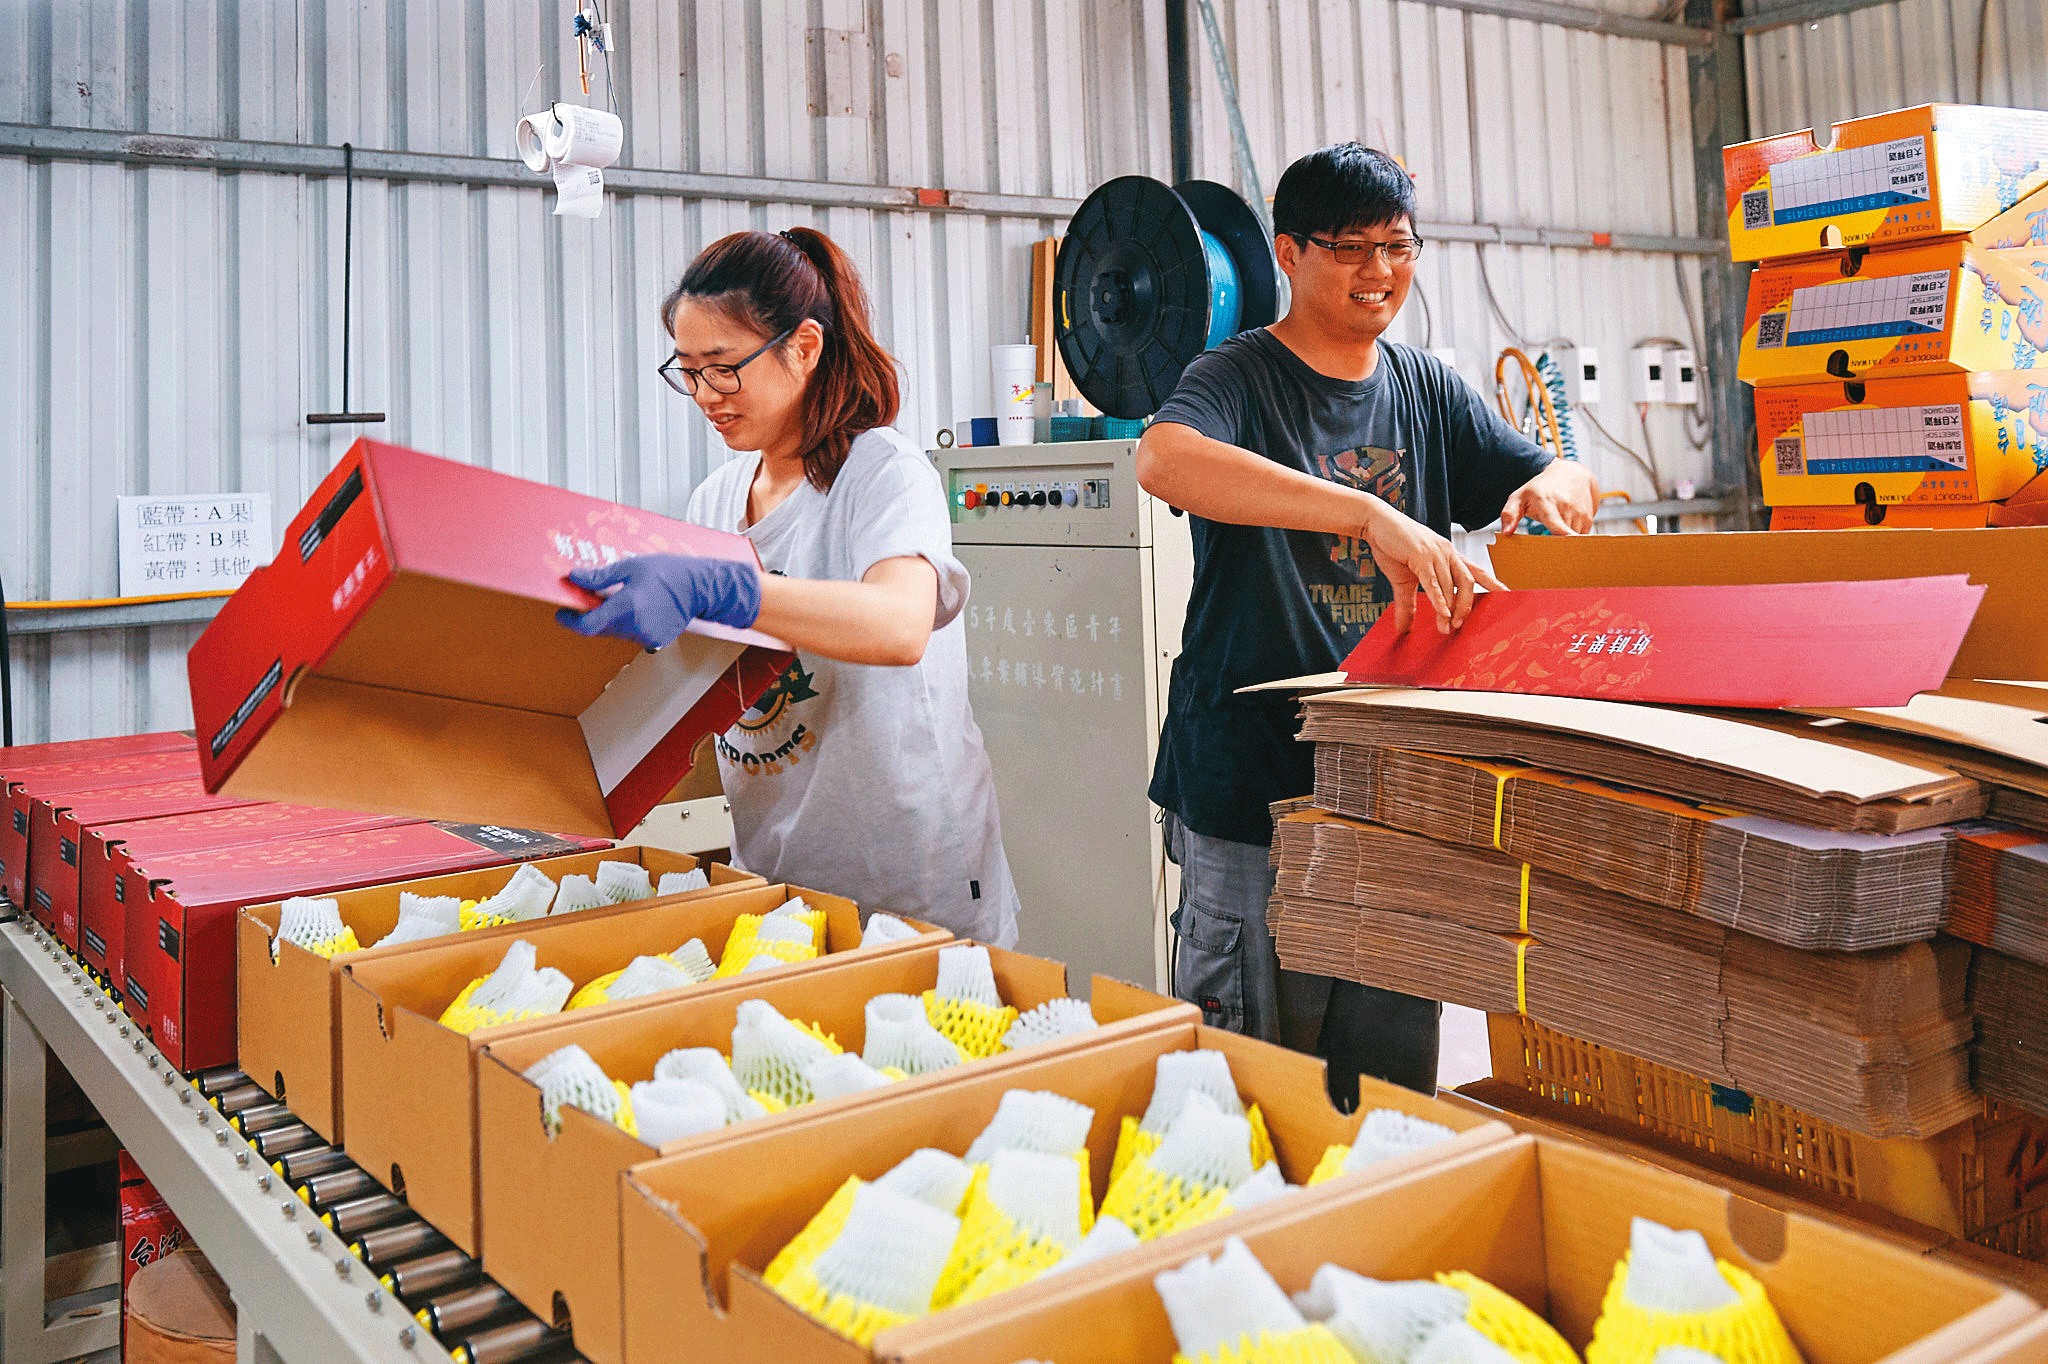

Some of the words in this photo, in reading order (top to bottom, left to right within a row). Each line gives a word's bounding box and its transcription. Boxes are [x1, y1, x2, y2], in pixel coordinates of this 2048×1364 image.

[1858, 199, 1864, 208] 9
[1869, 197, 1875, 206] 8
[1882, 196, 1888, 205] 7
[1881, 229, 1892, 238] OF
[1897, 224, 1935, 235] PRODUCT
[1844, 232, 1875, 242] TAIWAN
[1872, 326, 1878, 334] 9
[1896, 325, 1902, 333] 7
[1905, 353, 1943, 362] PRODUCT
[1850, 358, 1882, 367] TAIWAN
[1893, 461, 1899, 469] 9
[1905, 460, 1911, 469] 8
[1918, 459, 1923, 468] 7
[1878, 494, 1911, 502] TAIWAN
[1934, 493, 1973, 501] PRODUCT
[1308, 583, 1373, 604] TRANS
[717, 722, 817, 777] SPORTS
